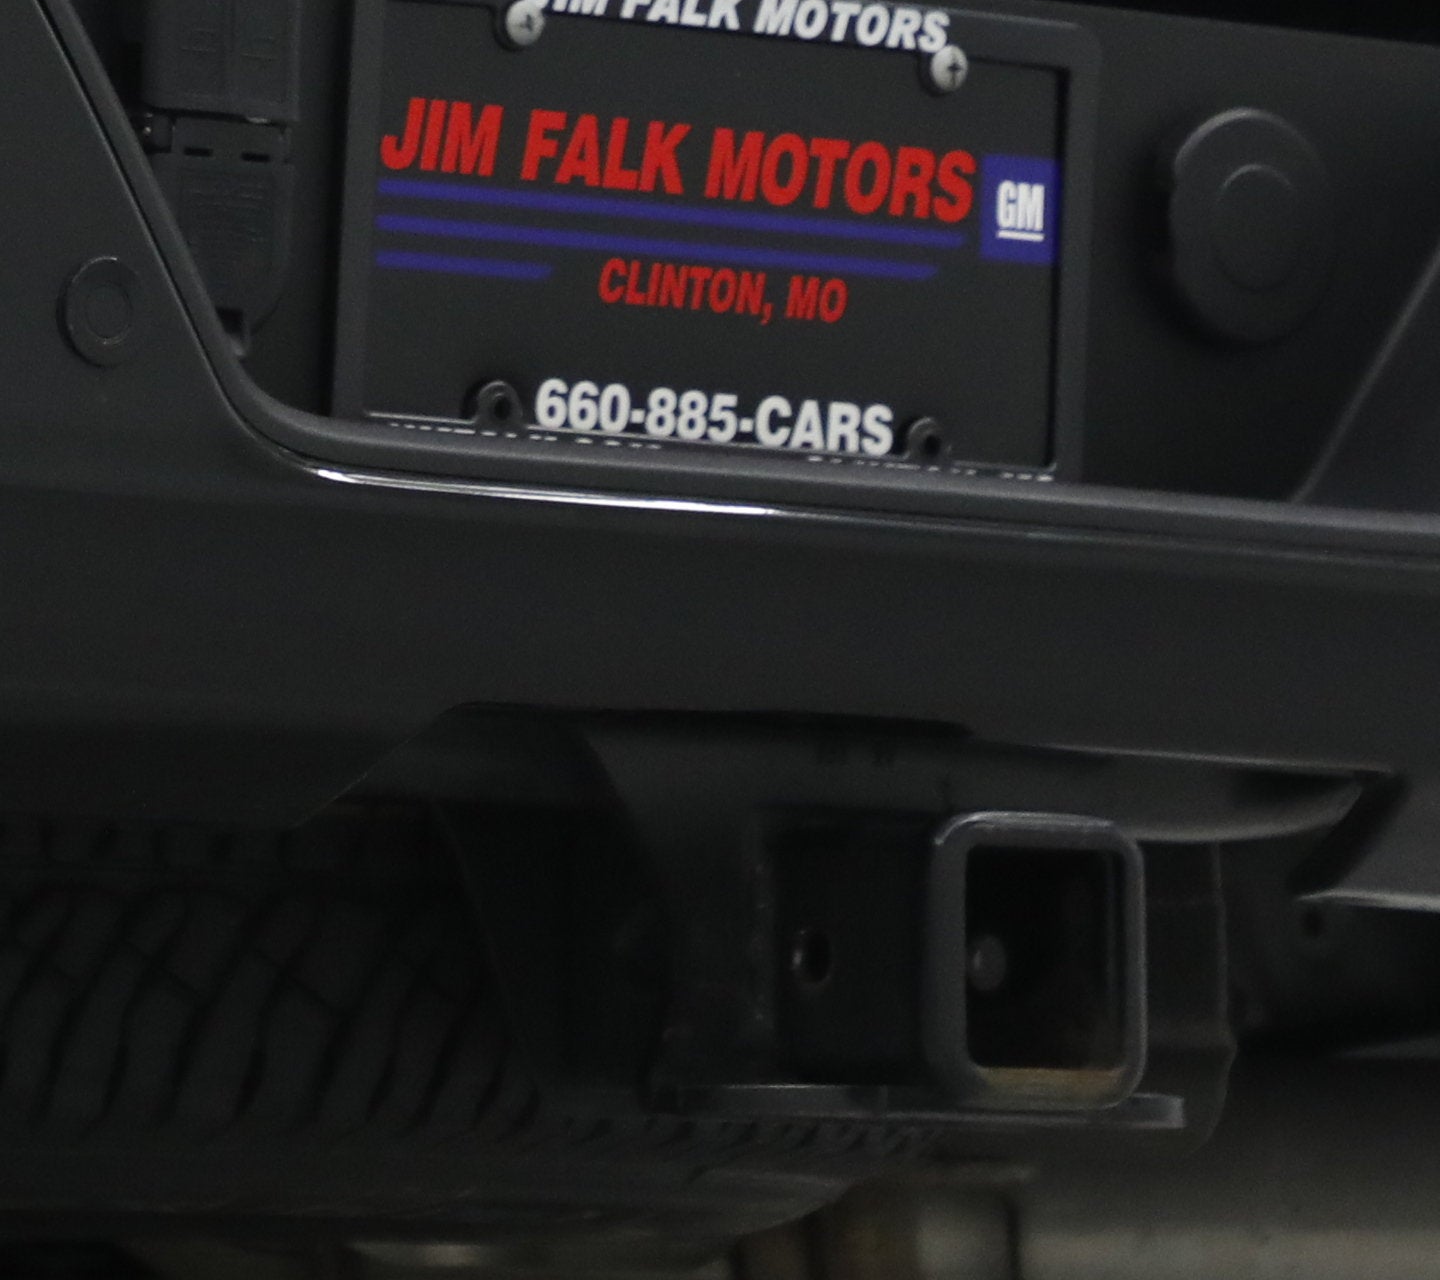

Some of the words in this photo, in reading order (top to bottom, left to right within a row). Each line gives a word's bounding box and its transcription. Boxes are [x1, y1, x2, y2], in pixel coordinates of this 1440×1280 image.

[379, 96, 504, 178] JIM
[519, 108, 693, 195] FALK
[704, 127, 978, 224] MOTORS
[996, 180, 1045, 233] GM
[597, 257, 772, 325] CLINTON,
[783, 274, 849, 324] MO
[534, 377, 895, 457] 660-885-CARS
